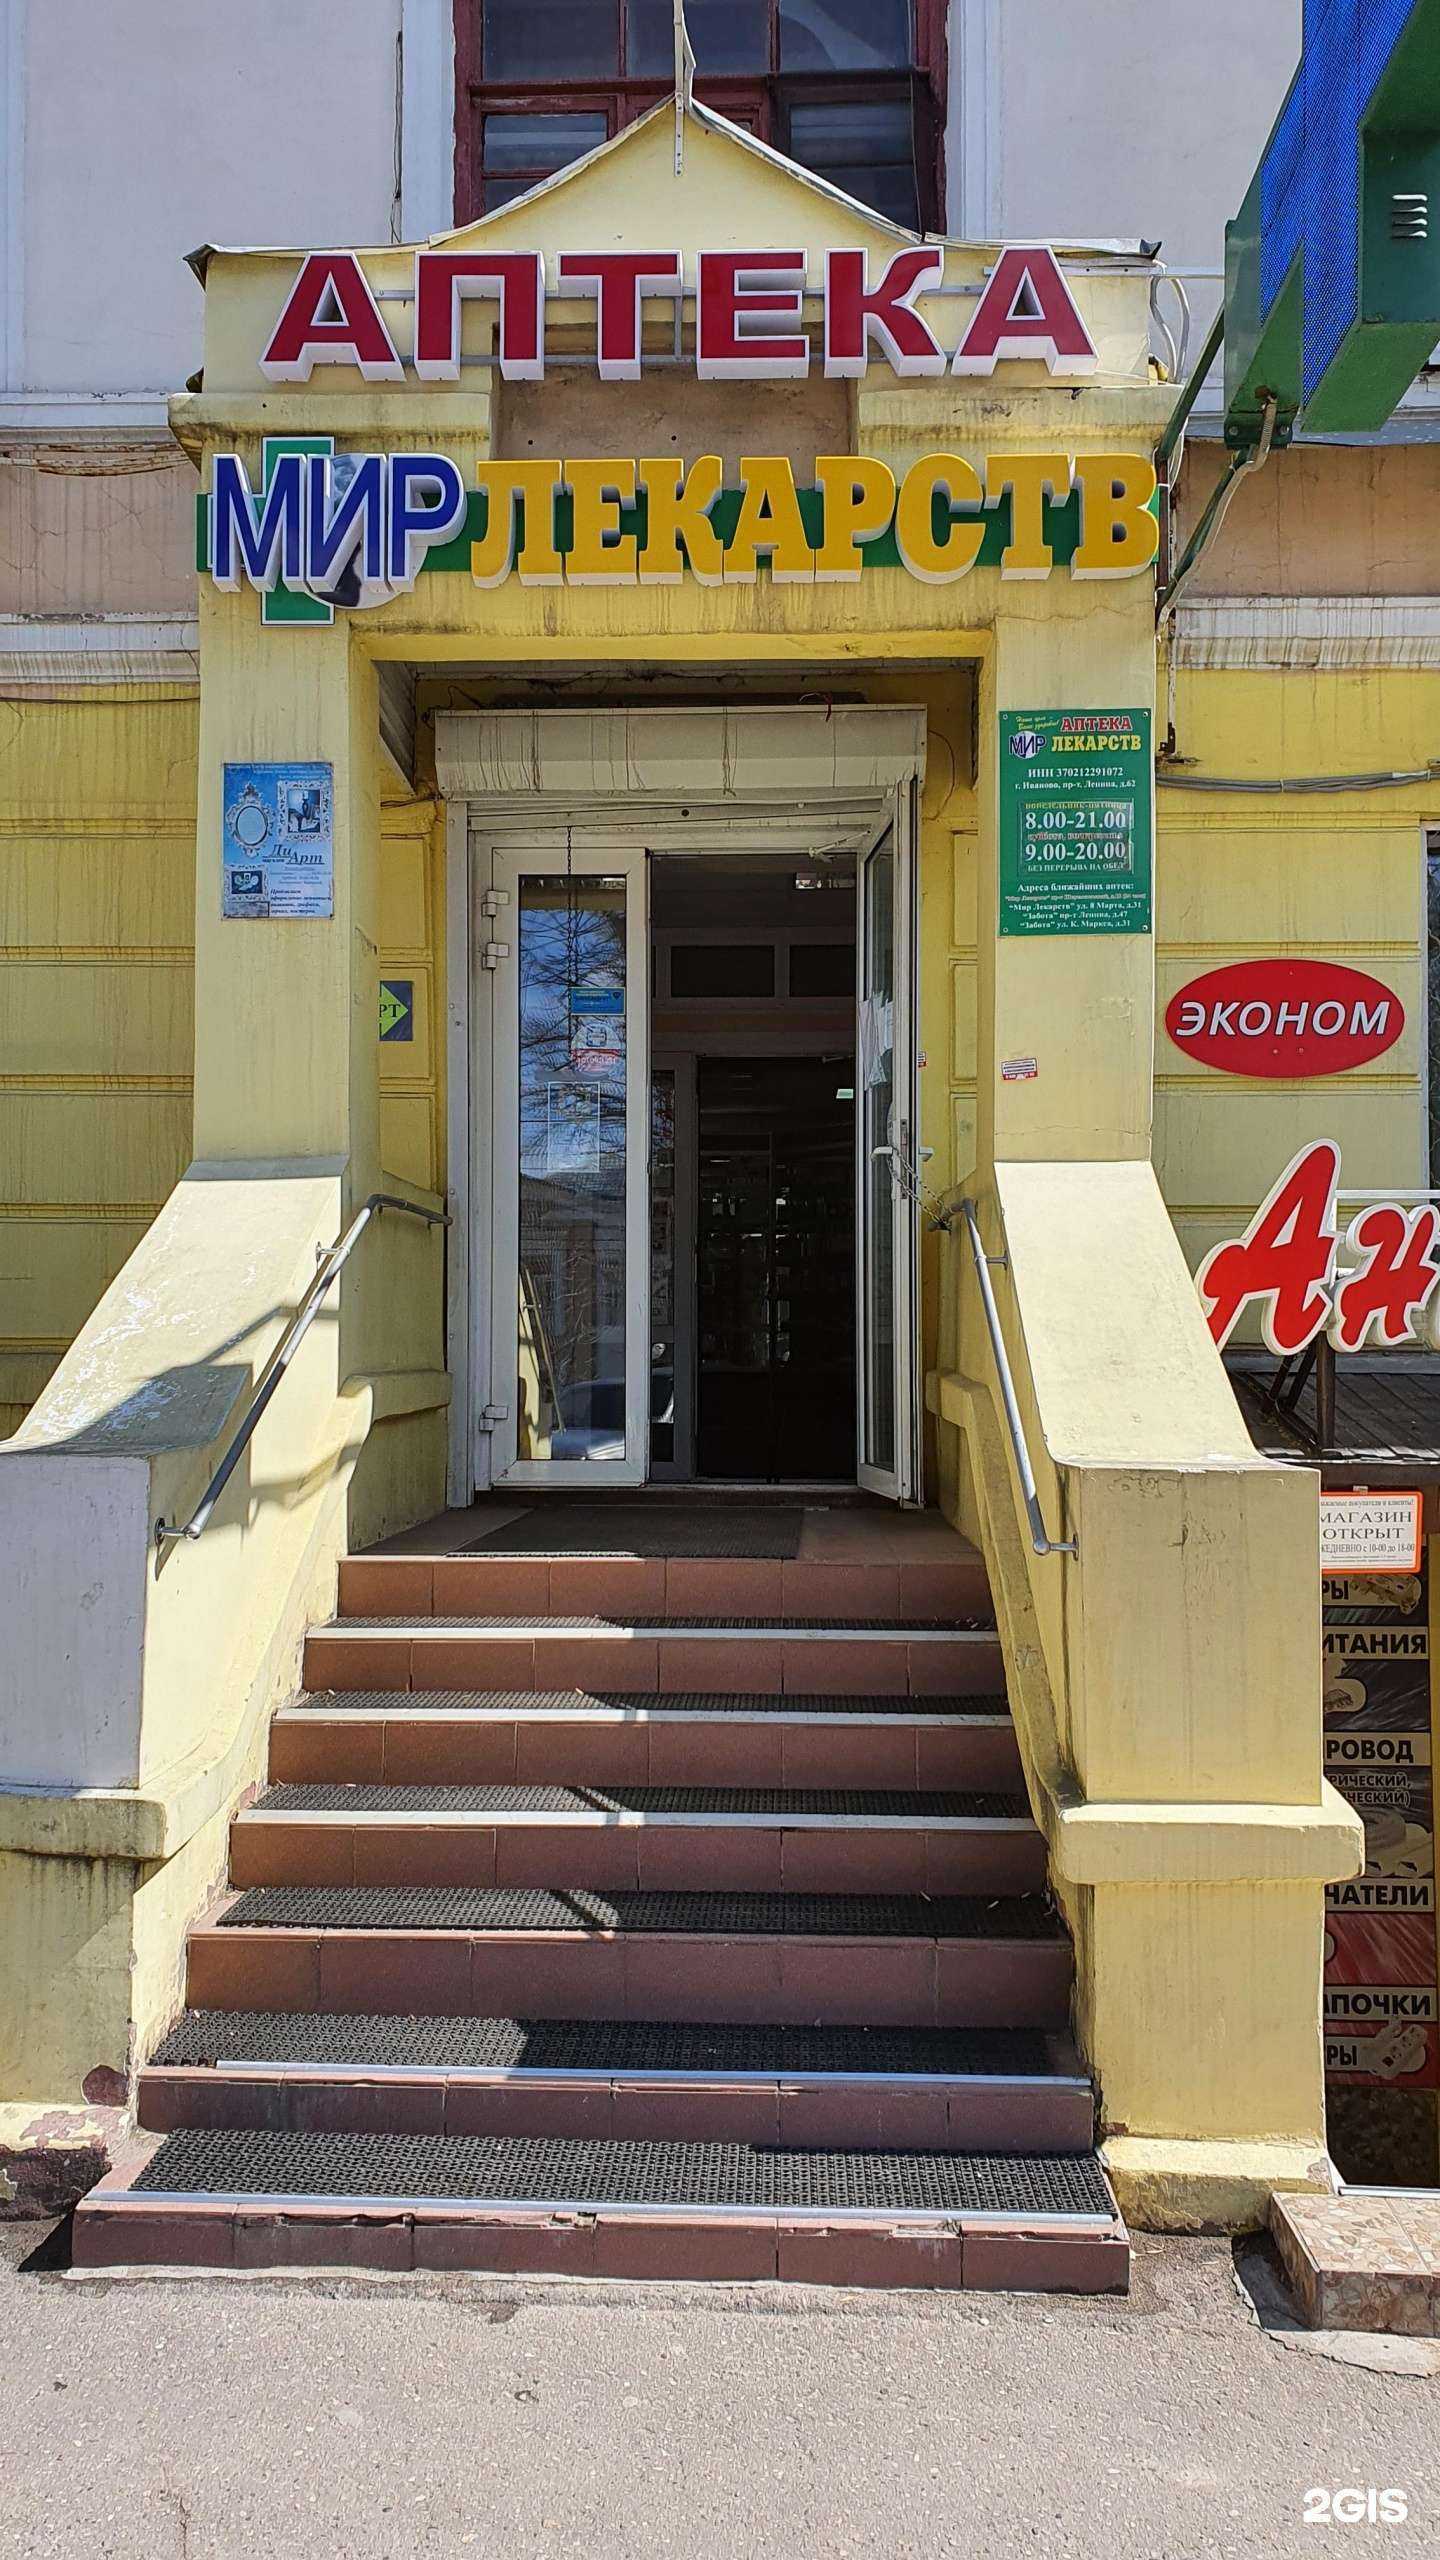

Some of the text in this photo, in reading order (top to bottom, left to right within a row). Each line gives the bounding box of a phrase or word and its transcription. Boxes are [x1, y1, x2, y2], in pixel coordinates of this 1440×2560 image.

[260, 245, 1099, 382] АПТЕКА
[208, 452, 1160, 593] МИР ЛЕКАРСТВ
[1060, 715, 1133, 732] АПТЕКА
[1009, 733, 1142, 757] МИР ЛЕКАРСТВ
[1028, 768, 1054, 778] ИНН
[1025, 810, 1127, 829] 8.00-21.00
[1025, 842, 1127, 861] 9.00-20.00
[1175, 1000, 1391, 1038] ЭКОНОМ
[1323, 1527, 1405, 1540] ОТКРЫТ
[1326, 1739, 1414, 1764] РОВОД
[1324, 1884, 1429, 1906] ЧАТЕЛИ
[1326, 2044, 1357, 2066] РЫ
